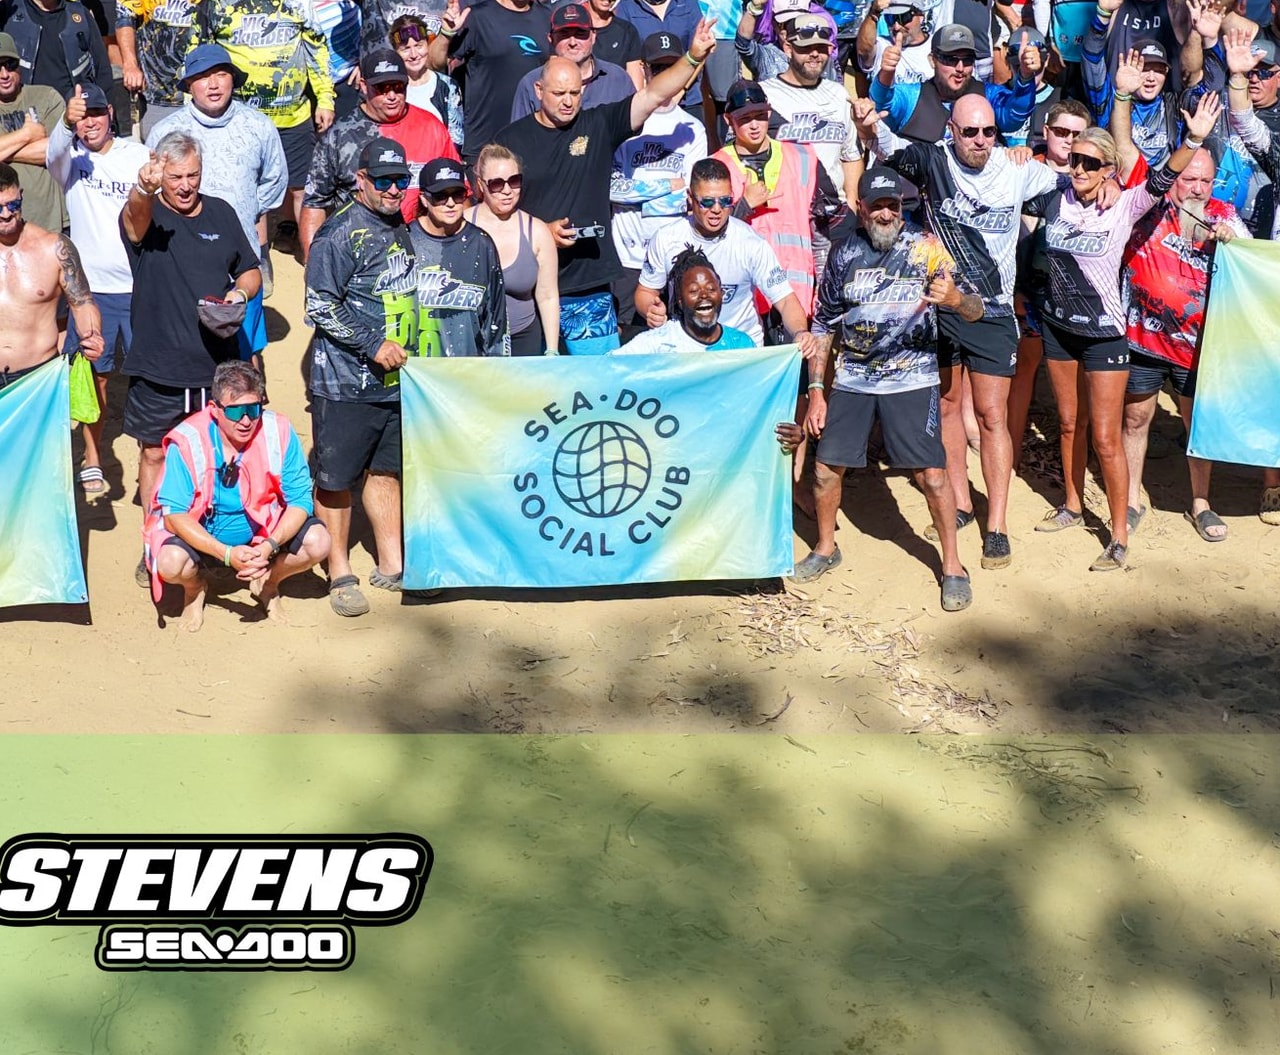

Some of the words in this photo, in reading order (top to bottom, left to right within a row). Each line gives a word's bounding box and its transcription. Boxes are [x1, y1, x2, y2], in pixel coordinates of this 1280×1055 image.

[660, 36, 671, 50] B
[513, 471, 616, 558] SOCIAL
[627, 465, 692, 546] CLUB
